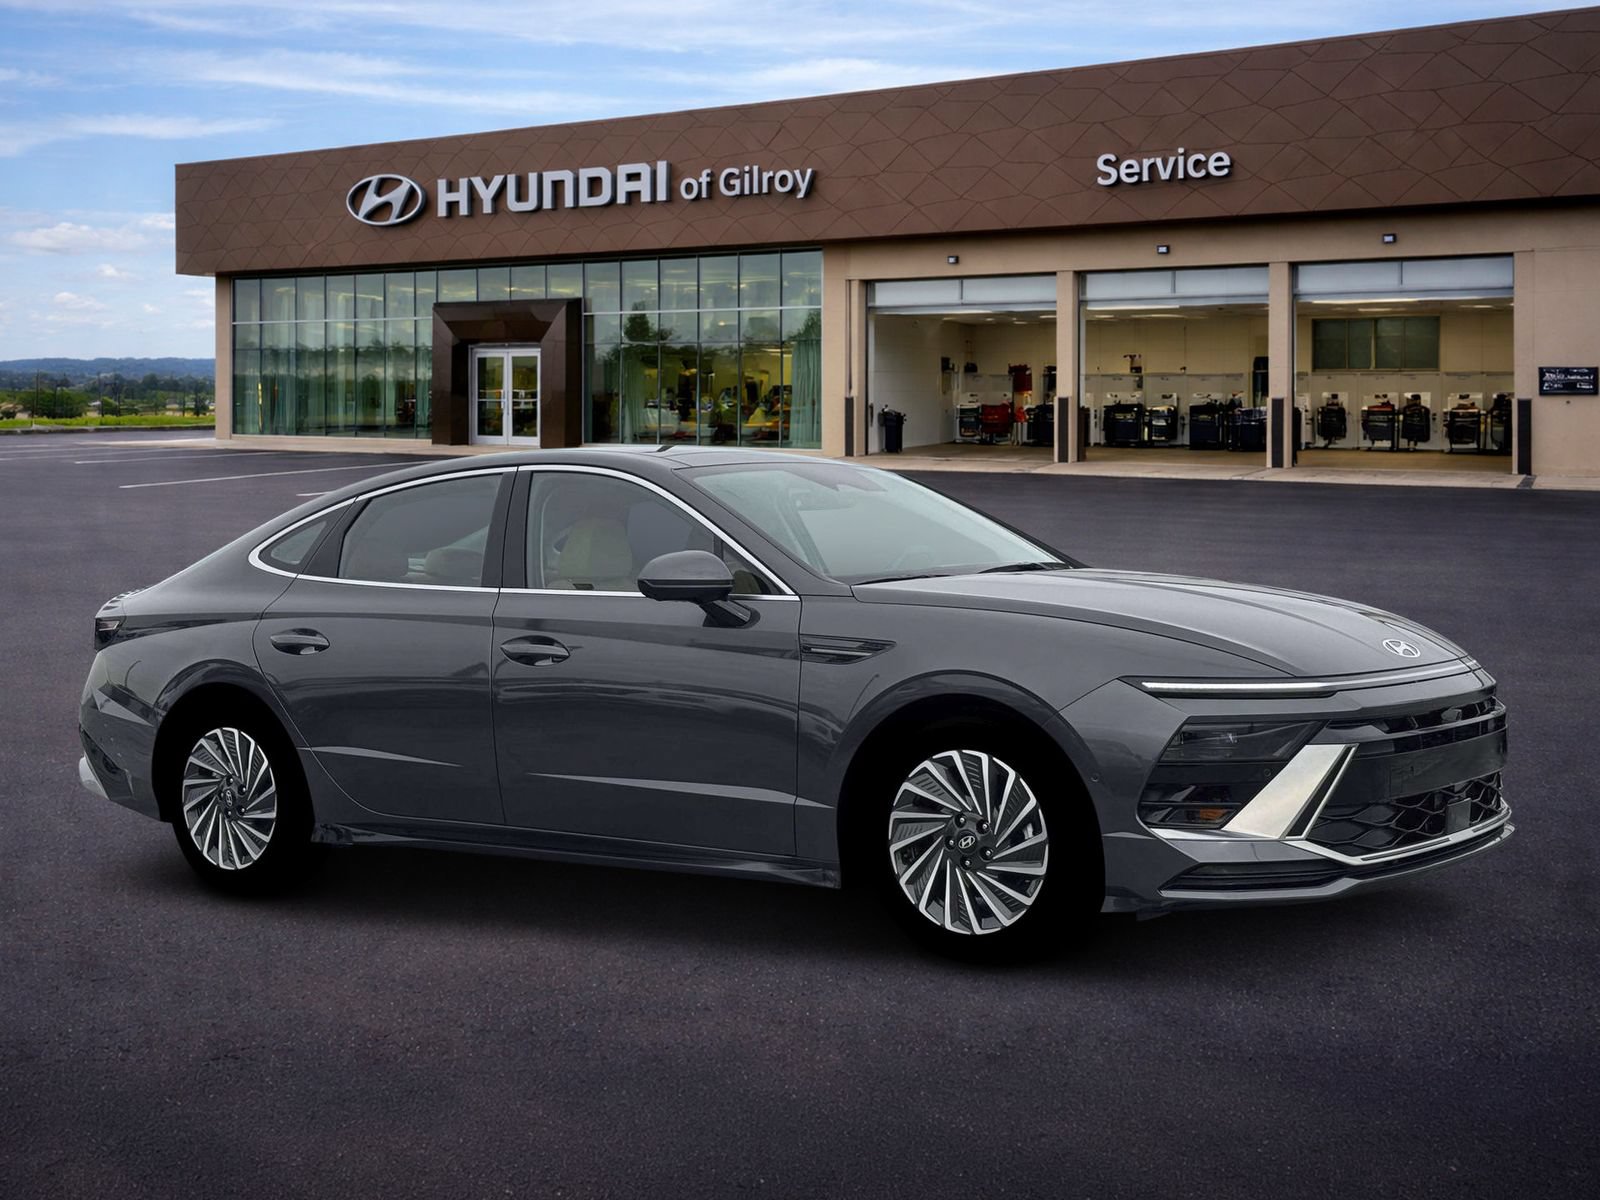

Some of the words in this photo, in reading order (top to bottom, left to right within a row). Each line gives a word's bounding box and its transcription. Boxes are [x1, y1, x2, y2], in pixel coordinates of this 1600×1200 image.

[436, 160, 669, 217] HYUNDAI
[680, 168, 712, 200] of
[718, 164, 814, 198] Gilroy
[1096, 147, 1231, 186] Service
